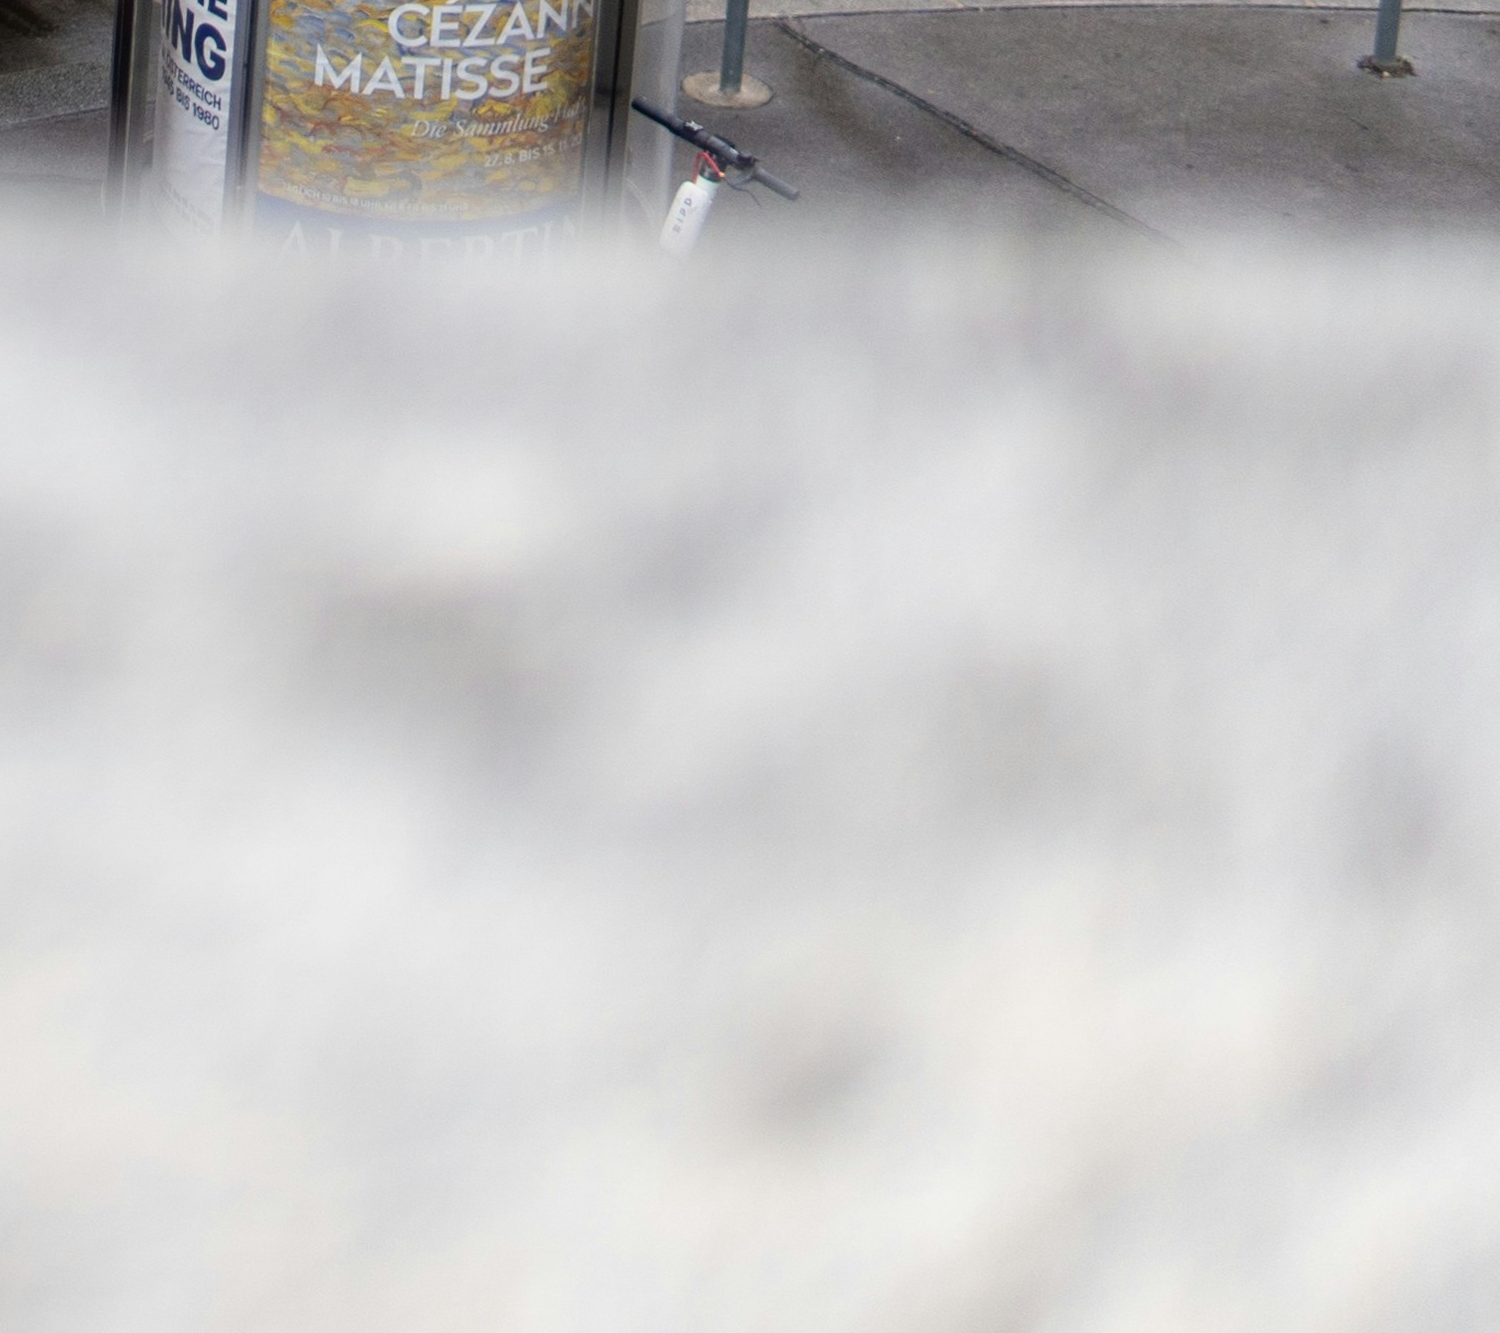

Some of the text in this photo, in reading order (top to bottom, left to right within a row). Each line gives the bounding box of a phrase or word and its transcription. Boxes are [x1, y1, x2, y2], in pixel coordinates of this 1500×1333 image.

[313, 42, 551, 101] MATISSE
[176, 86, 220, 131] BIS 1980
[411, 111, 550, 139] Die Sammlung
[519, 146, 541, 163] BIS
